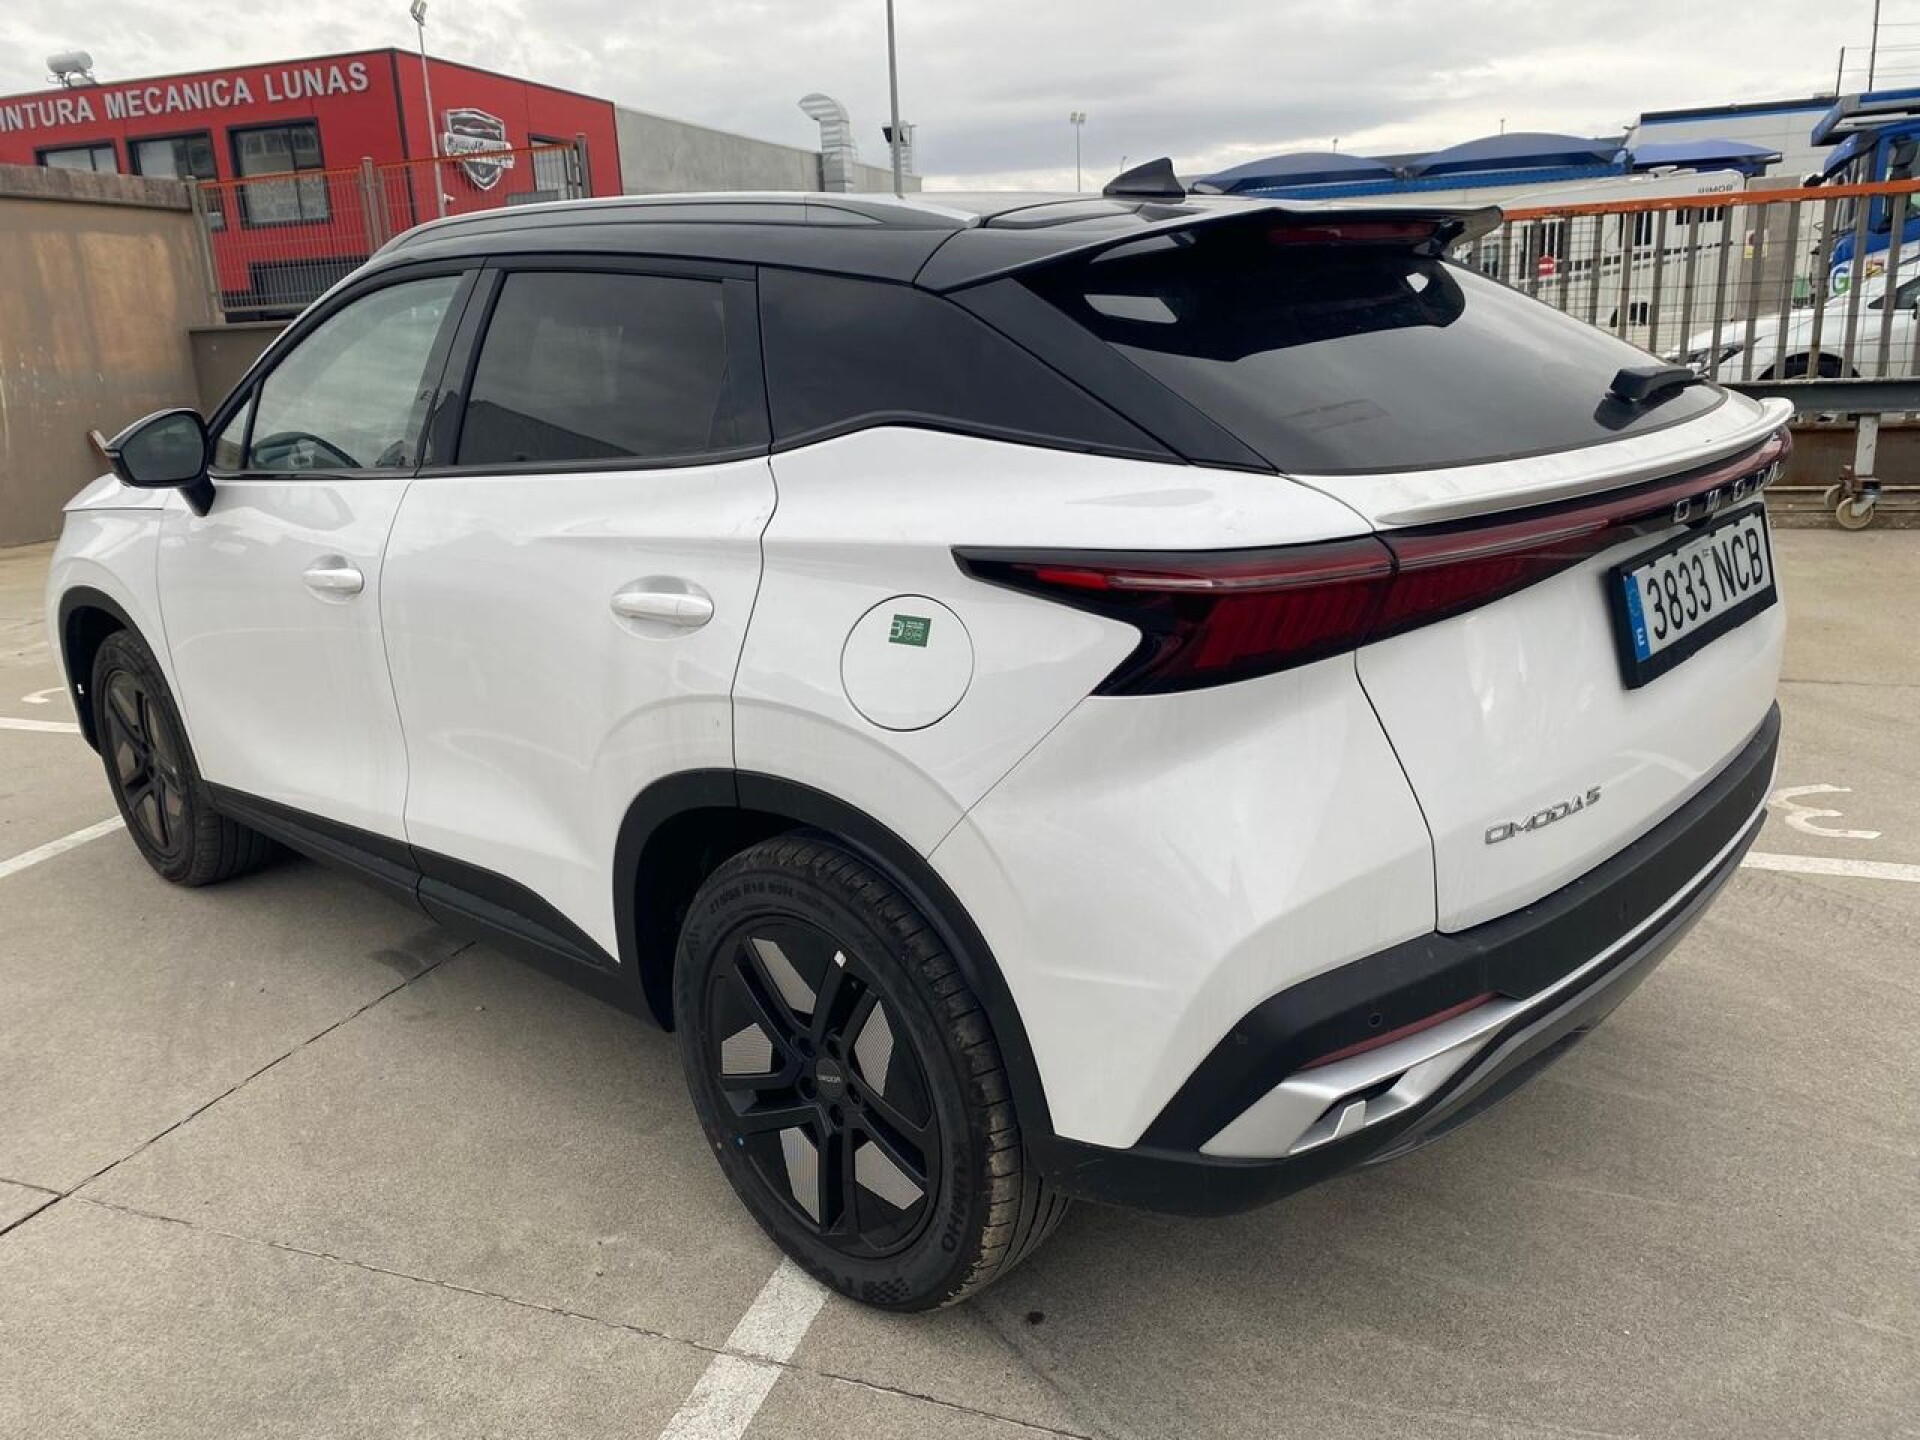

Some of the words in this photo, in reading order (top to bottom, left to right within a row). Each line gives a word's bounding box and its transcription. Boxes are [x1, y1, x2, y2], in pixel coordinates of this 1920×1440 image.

[104, 78, 254, 120] MECANICA
[264, 62, 370, 102] LUNAS
[1647, 553, 1712, 640] 3833
[1711, 527, 1763, 603] NCB
[1485, 794, 1584, 844] OMODA
[1586, 785, 1602, 807] 5
